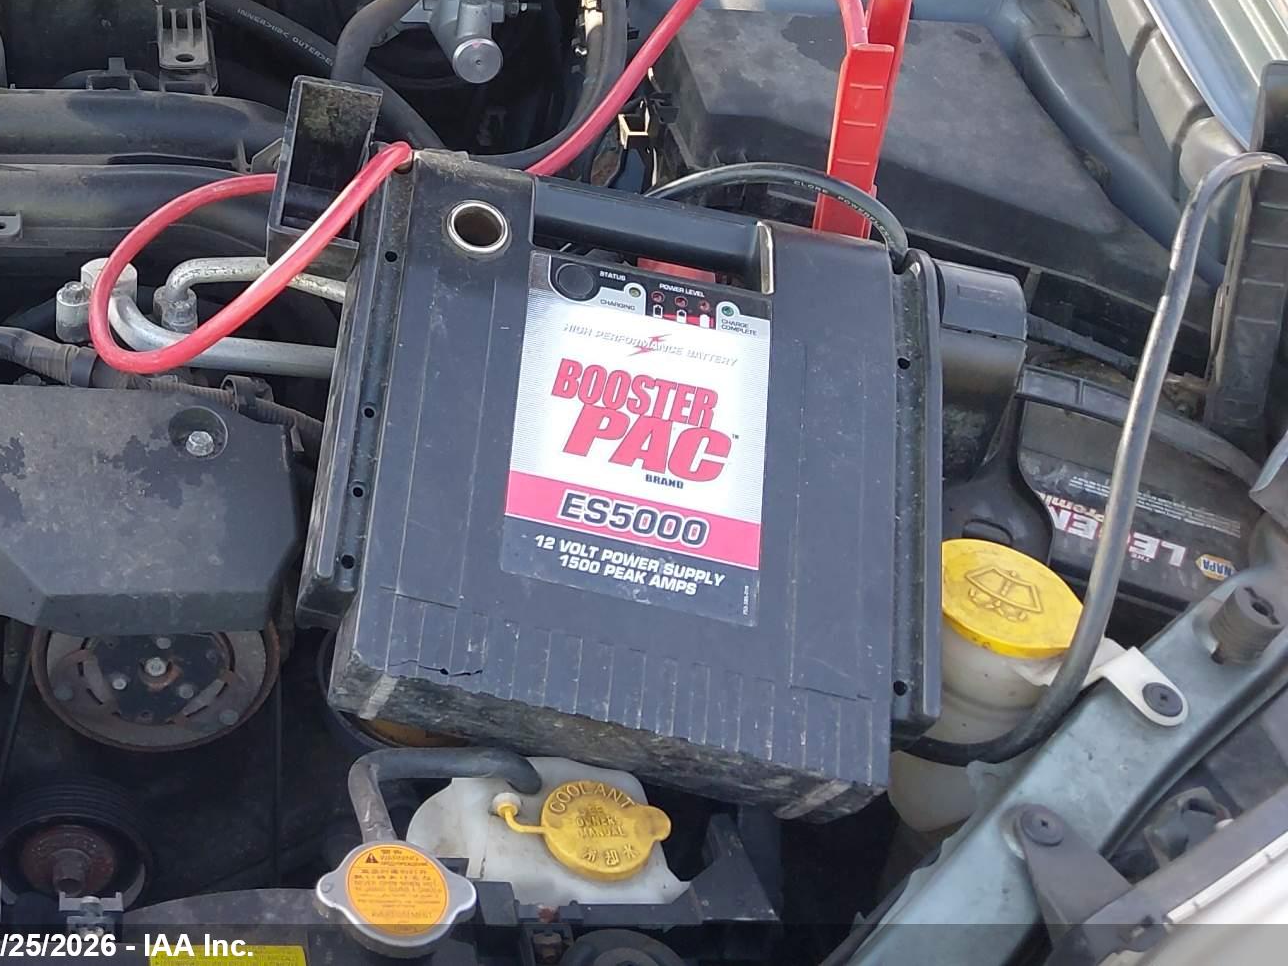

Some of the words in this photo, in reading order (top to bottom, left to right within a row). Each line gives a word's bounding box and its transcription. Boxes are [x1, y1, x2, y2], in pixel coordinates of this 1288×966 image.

[599, 270, 626, 282] STATUS
[659, 283, 684, 294] POWER
[684, 288, 705, 298] LEVEL
[600, 298, 636, 311] CHARGING
[721, 318, 750, 329] CHARGE
[721, 324, 758, 336] COMPLETE
[563, 323, 592, 337] HIGH
[595, 330, 683, 356] PERFORMANCE
[687, 345, 739, 367] BATTERY
[551, 358, 718, 428] BOOSTER
[562, 403, 732, 482] PAC
[645, 473, 684, 489] BRAND
[559, 490, 709, 548] ES5000
[534, 534, 556, 551] 12
[559, 539, 600, 560] VOLT
[601, 547, 660, 573] POWER
[662, 561, 726, 587] SUPPLY
[1130, 553, 1151, 563] THE
[1201, 558, 1233, 577] NAPA
[559, 554, 600, 575] 1500
[603, 563, 646, 585] PEAK
[649, 575, 697, 596] AMPS
[549, 781, 636, 813] COOLANT
